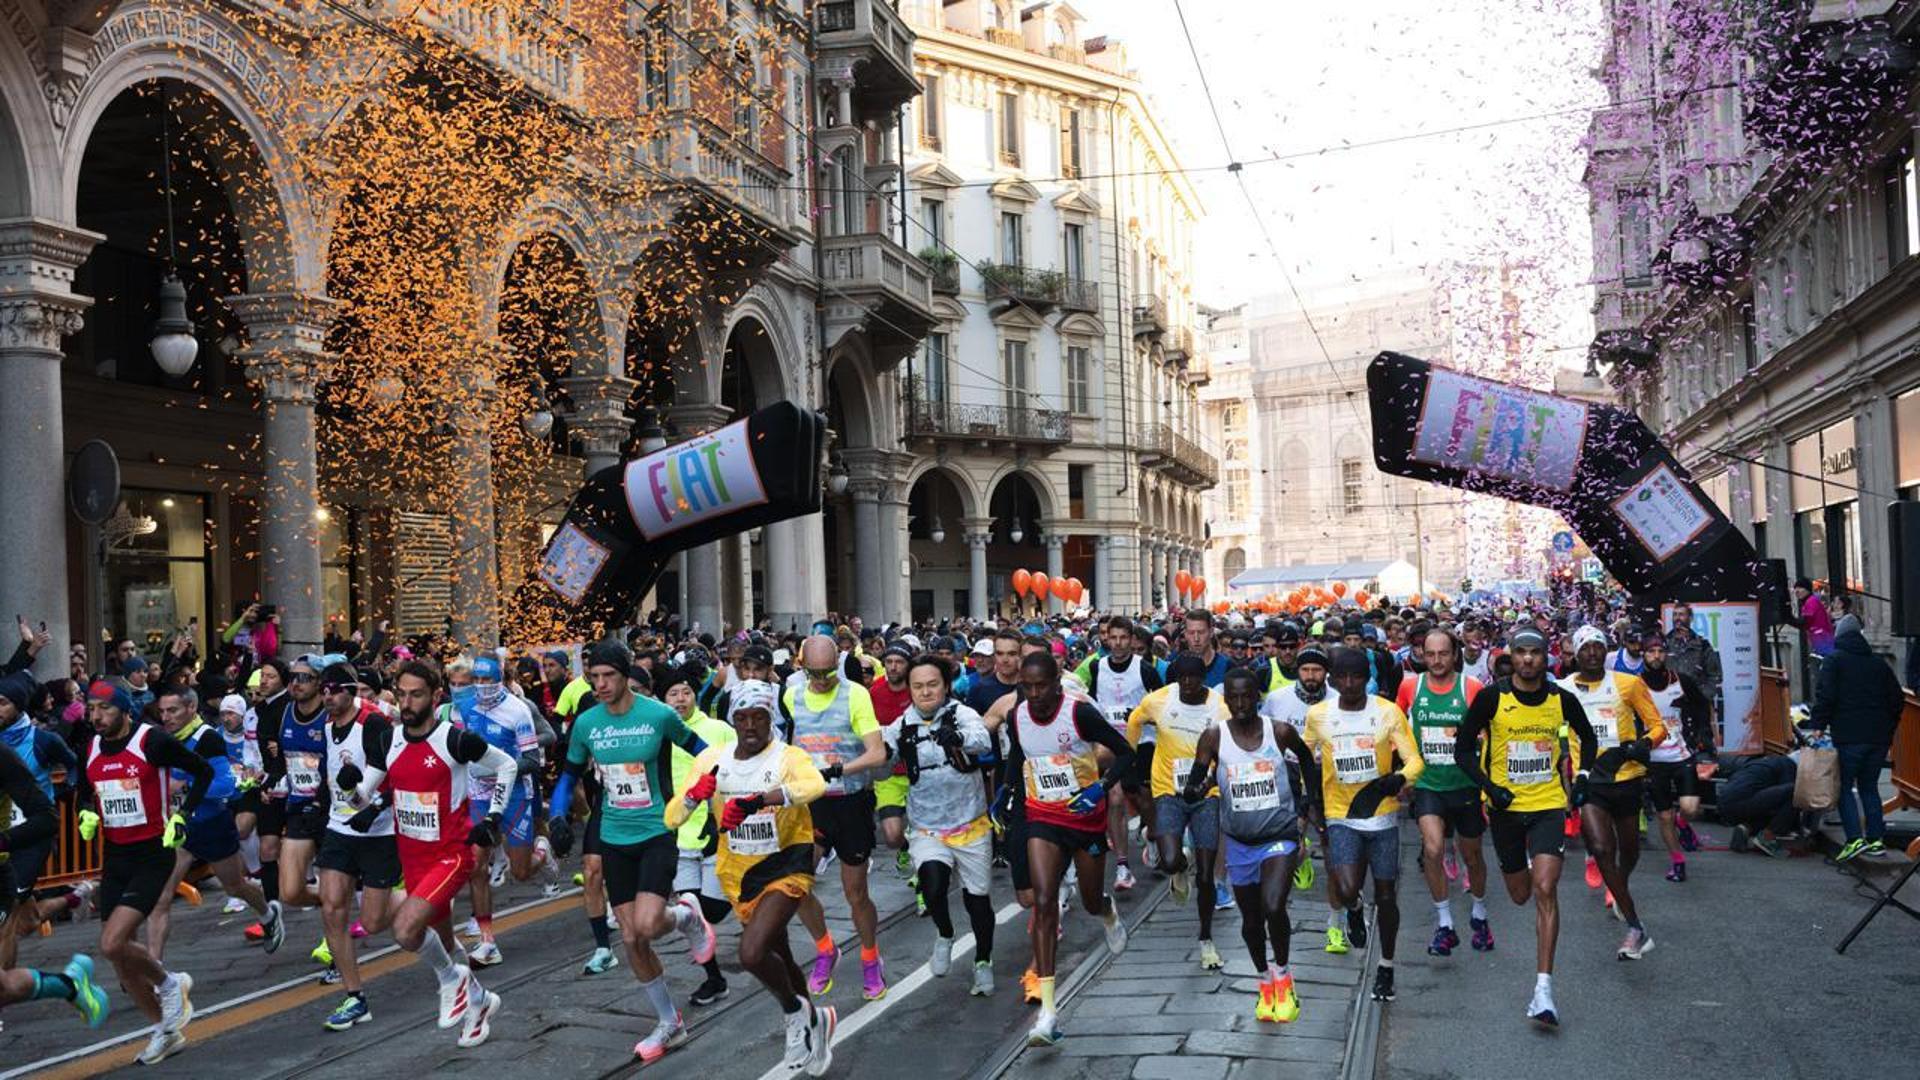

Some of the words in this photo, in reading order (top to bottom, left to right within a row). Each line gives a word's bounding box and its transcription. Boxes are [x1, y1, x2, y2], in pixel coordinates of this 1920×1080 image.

[648, 440, 730, 523] FIAT
[1335, 755, 1375, 772] MURITHI
[616, 783, 632, 795] 20
[1039, 772, 1069, 789] LETING
[1231, 779, 1275, 799] KIPROTICH
[104, 797, 137, 815] SPITERI
[397, 809, 436, 828] PERCONTE
[730, 821, 773, 840] WAITHIRA
